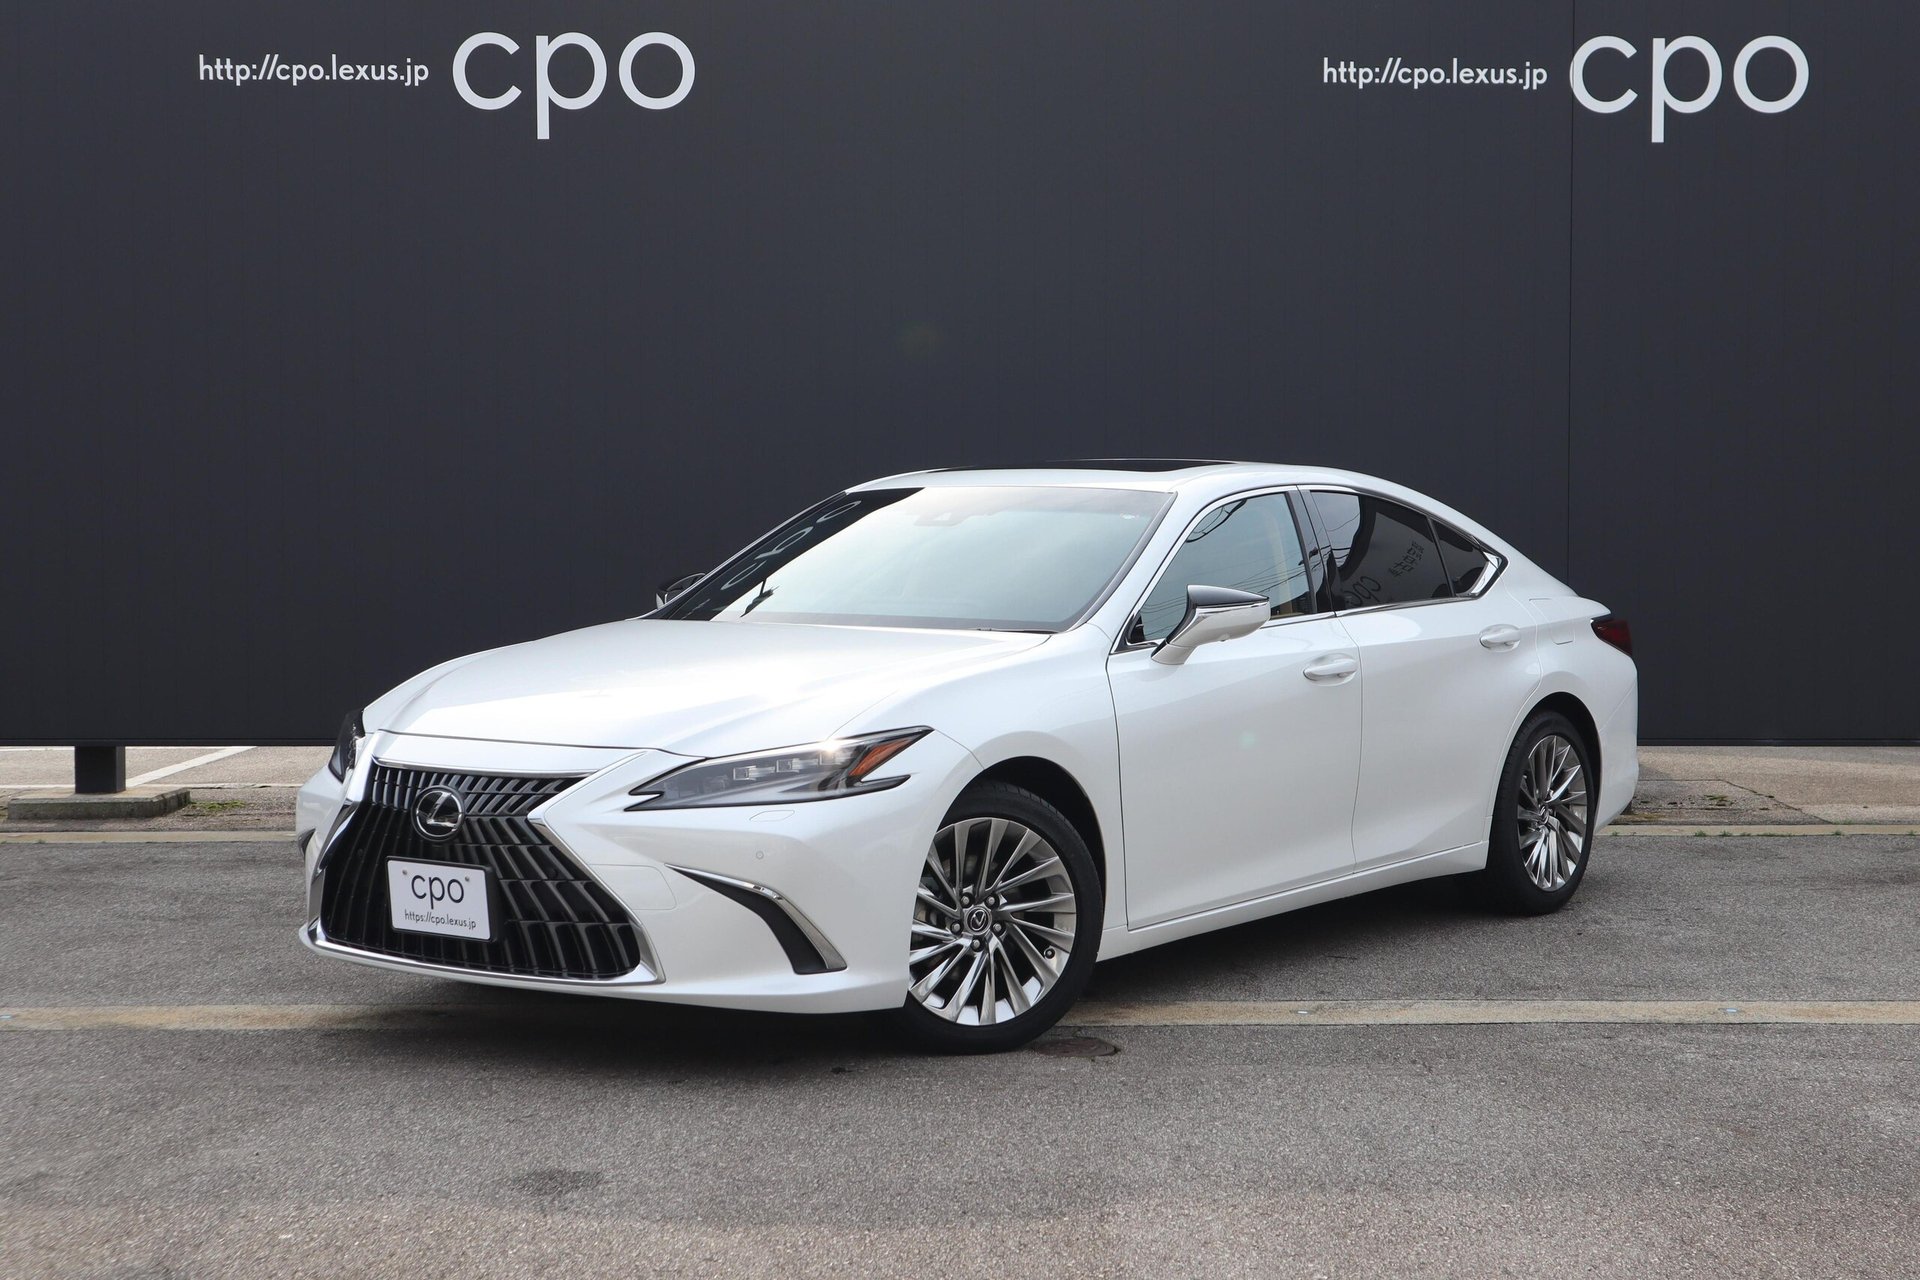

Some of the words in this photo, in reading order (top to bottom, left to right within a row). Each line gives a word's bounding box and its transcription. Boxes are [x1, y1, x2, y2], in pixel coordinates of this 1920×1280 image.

[199, 54, 428, 86] http://cpo.lexus.jp
[453, 32, 695, 139] cpo
[1324, 57, 1547, 89] http://cpo.lexus.jp
[1570, 36, 1809, 142] cpo
[404, 908, 477, 930] https://cpo.lexus.jp
[411, 875, 464, 910] cpo
